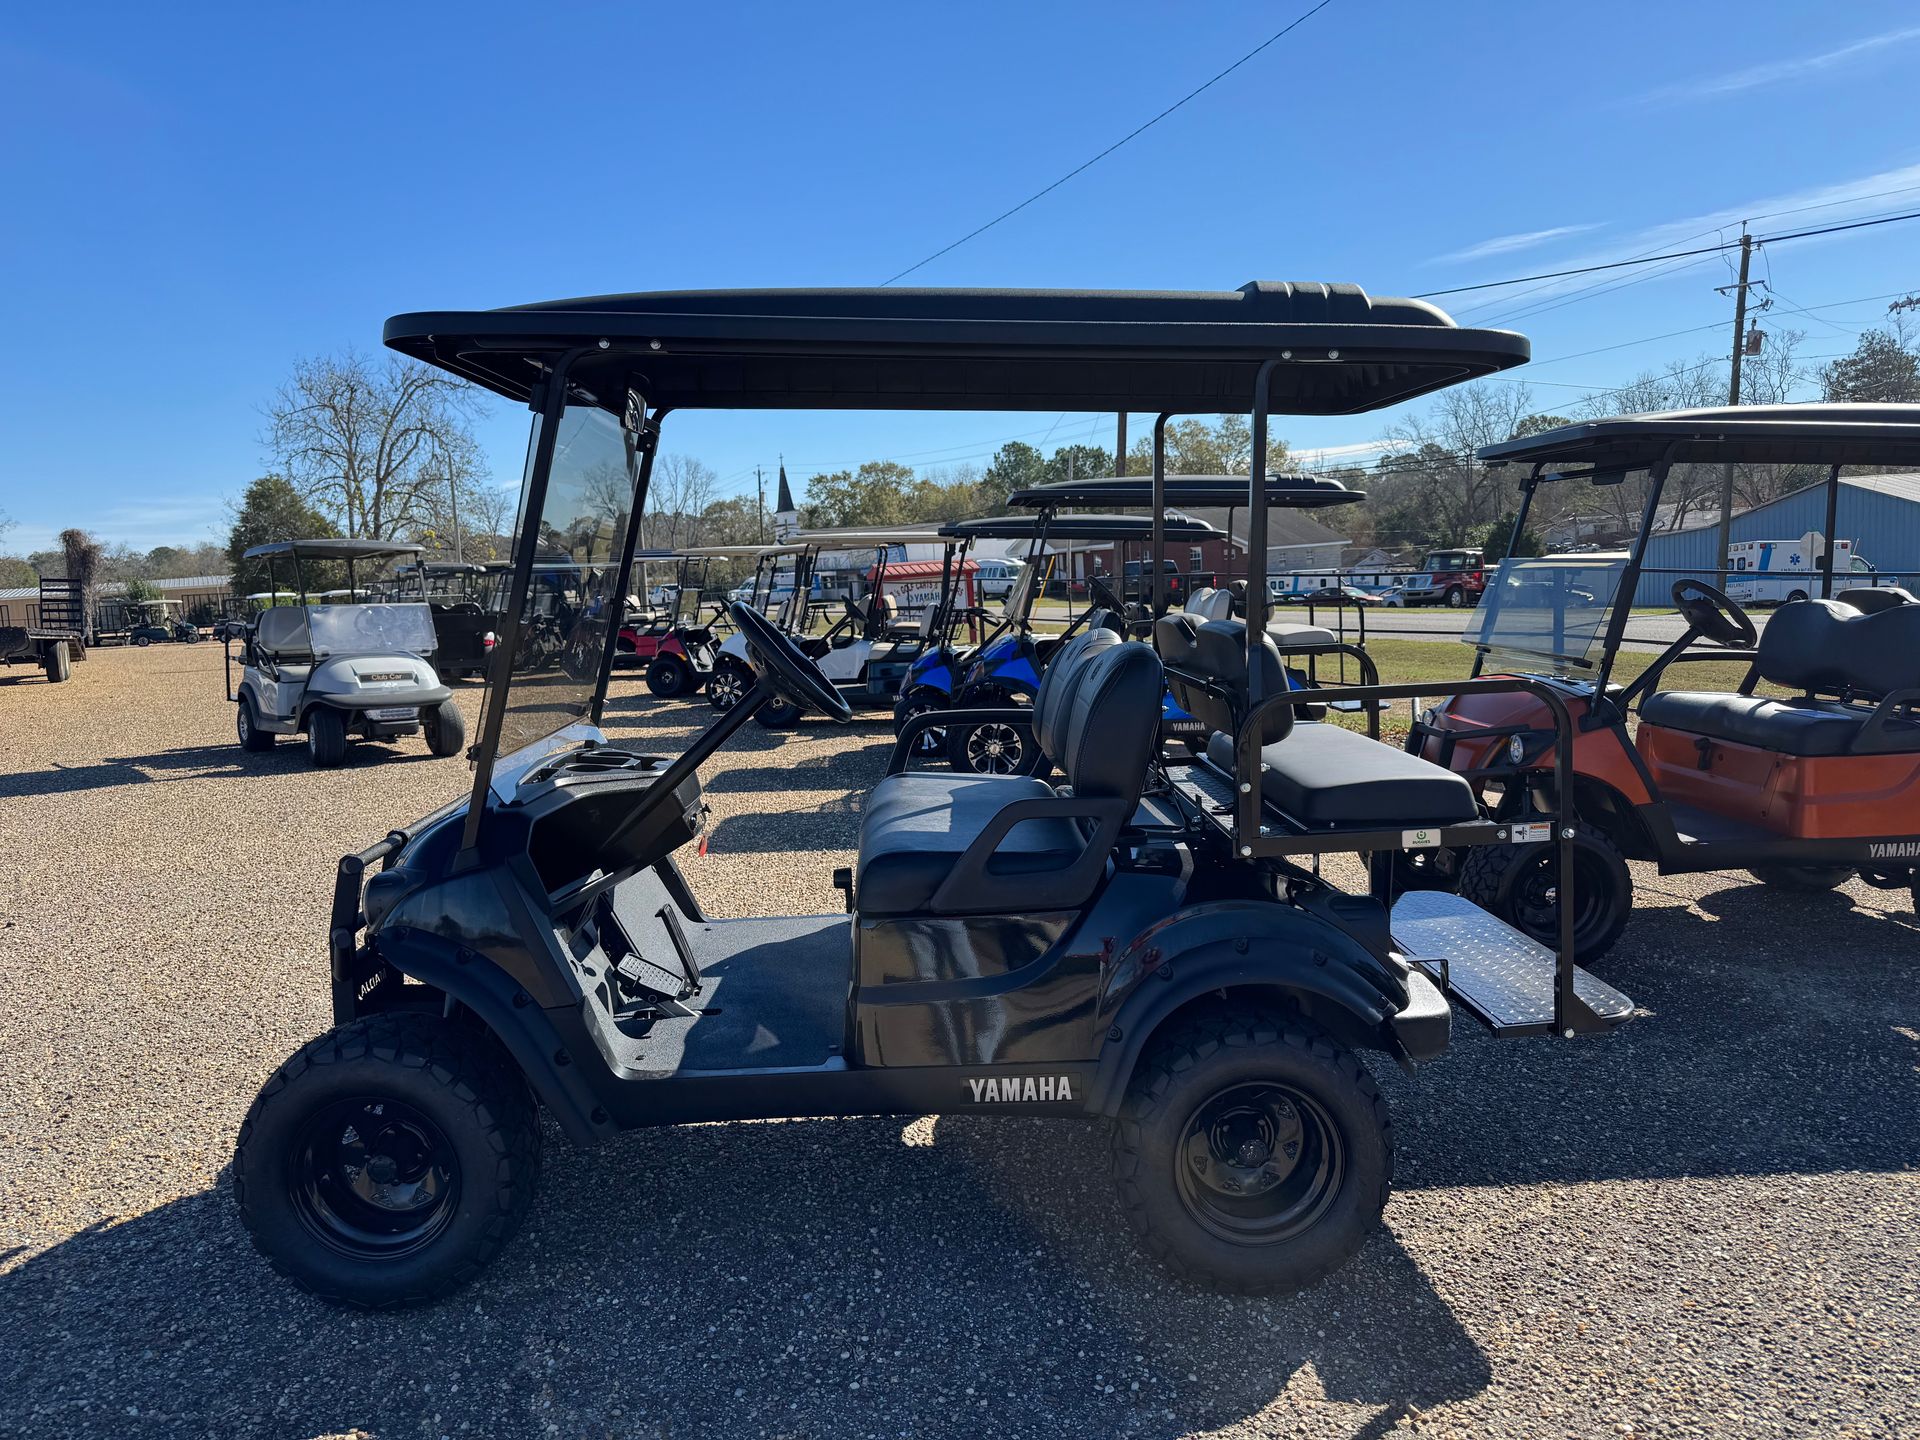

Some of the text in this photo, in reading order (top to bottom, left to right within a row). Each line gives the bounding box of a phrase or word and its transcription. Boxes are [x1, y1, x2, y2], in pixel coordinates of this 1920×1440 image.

[914, 592, 941, 603] YAMAH
[1172, 722, 1206, 732] YAMAHA
[968, 1076, 1072, 1103] YAMAHA
